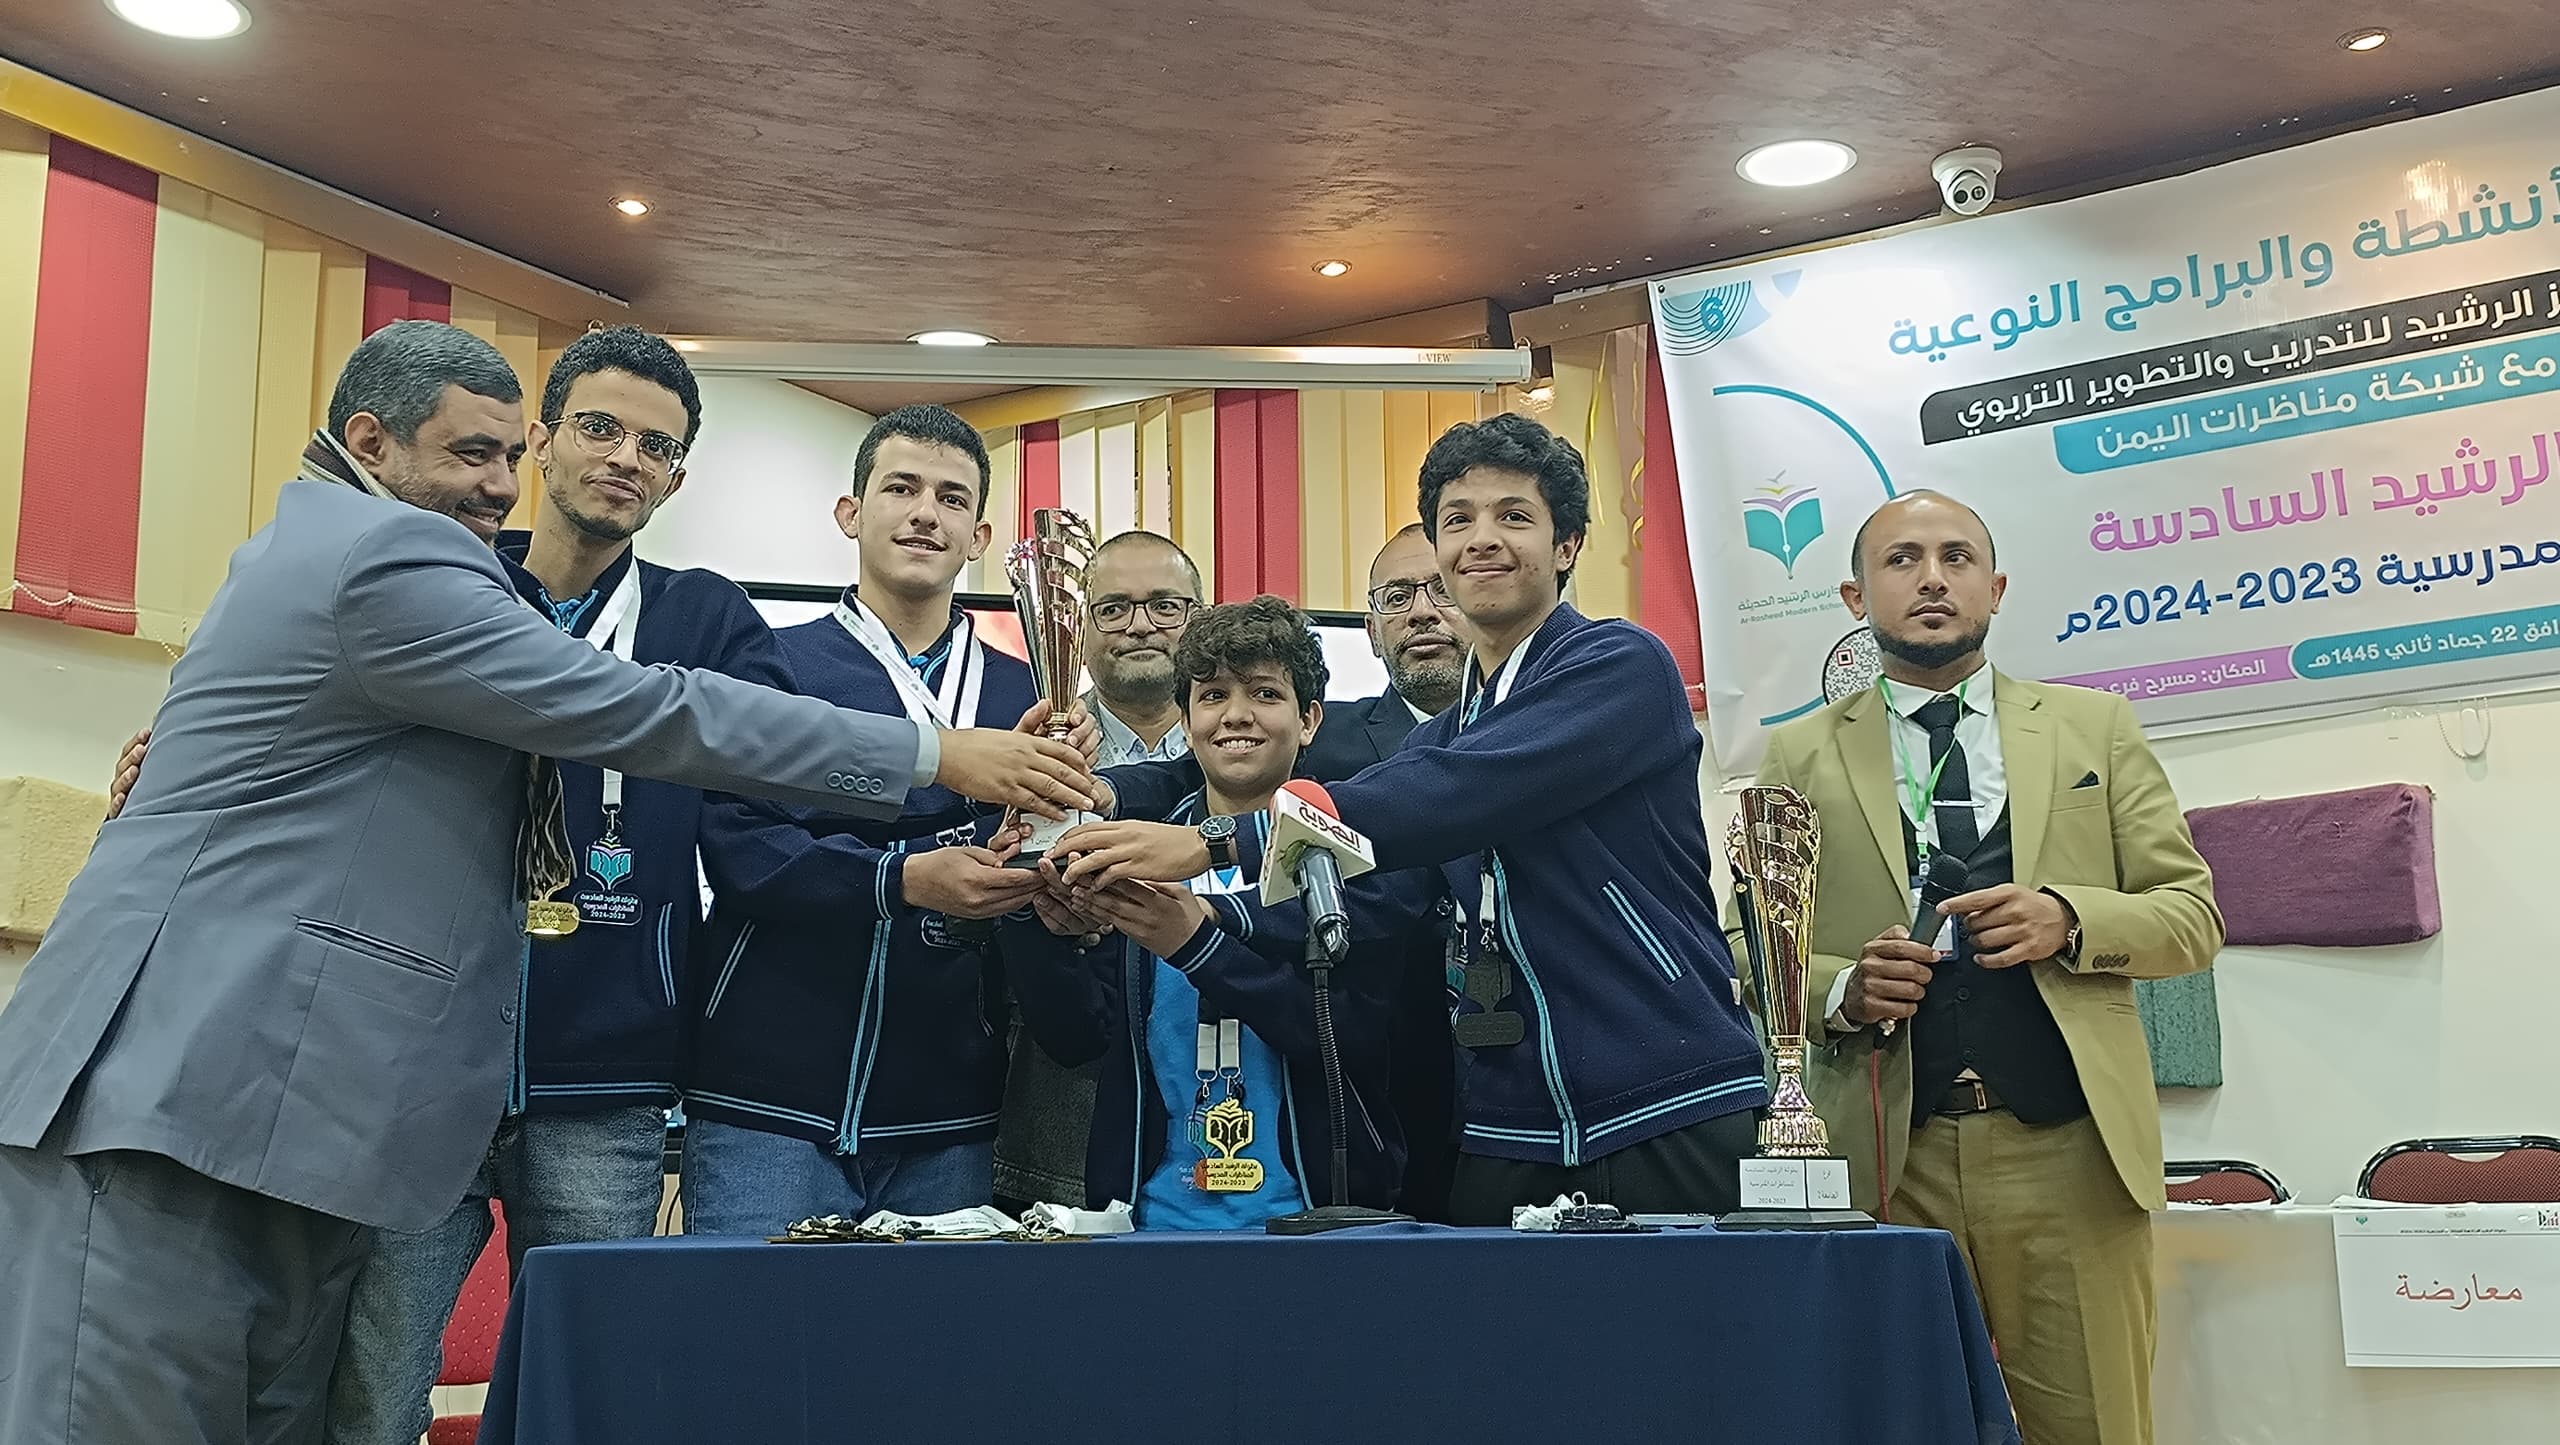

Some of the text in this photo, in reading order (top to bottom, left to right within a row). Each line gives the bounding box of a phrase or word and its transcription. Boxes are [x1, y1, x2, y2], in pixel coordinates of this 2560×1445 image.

[2103, 234, 2334, 332] والبرامج
[1701, 296, 1725, 332] 6
[1888, 279, 2081, 363] النوعية
[2404, 287, 2534, 343] الرشيد
[2243, 315, 2393, 374] للتدريب
[2085, 350, 2235, 406] والتطوير
[2095, 352, 2557, 458] مع شبكة مناظرات اليمن
[1956, 377, 2075, 436] التربوي
[2089, 467, 2349, 552] السادسة
[1785, 606, 1818, 617] Modern
[2490, 624, 2518, 643] 22
[2437, 632, 2487, 650] جماد
[2145, 673, 2197, 695] مسرح
[2396, 1273, 2523, 1310] معارضة
